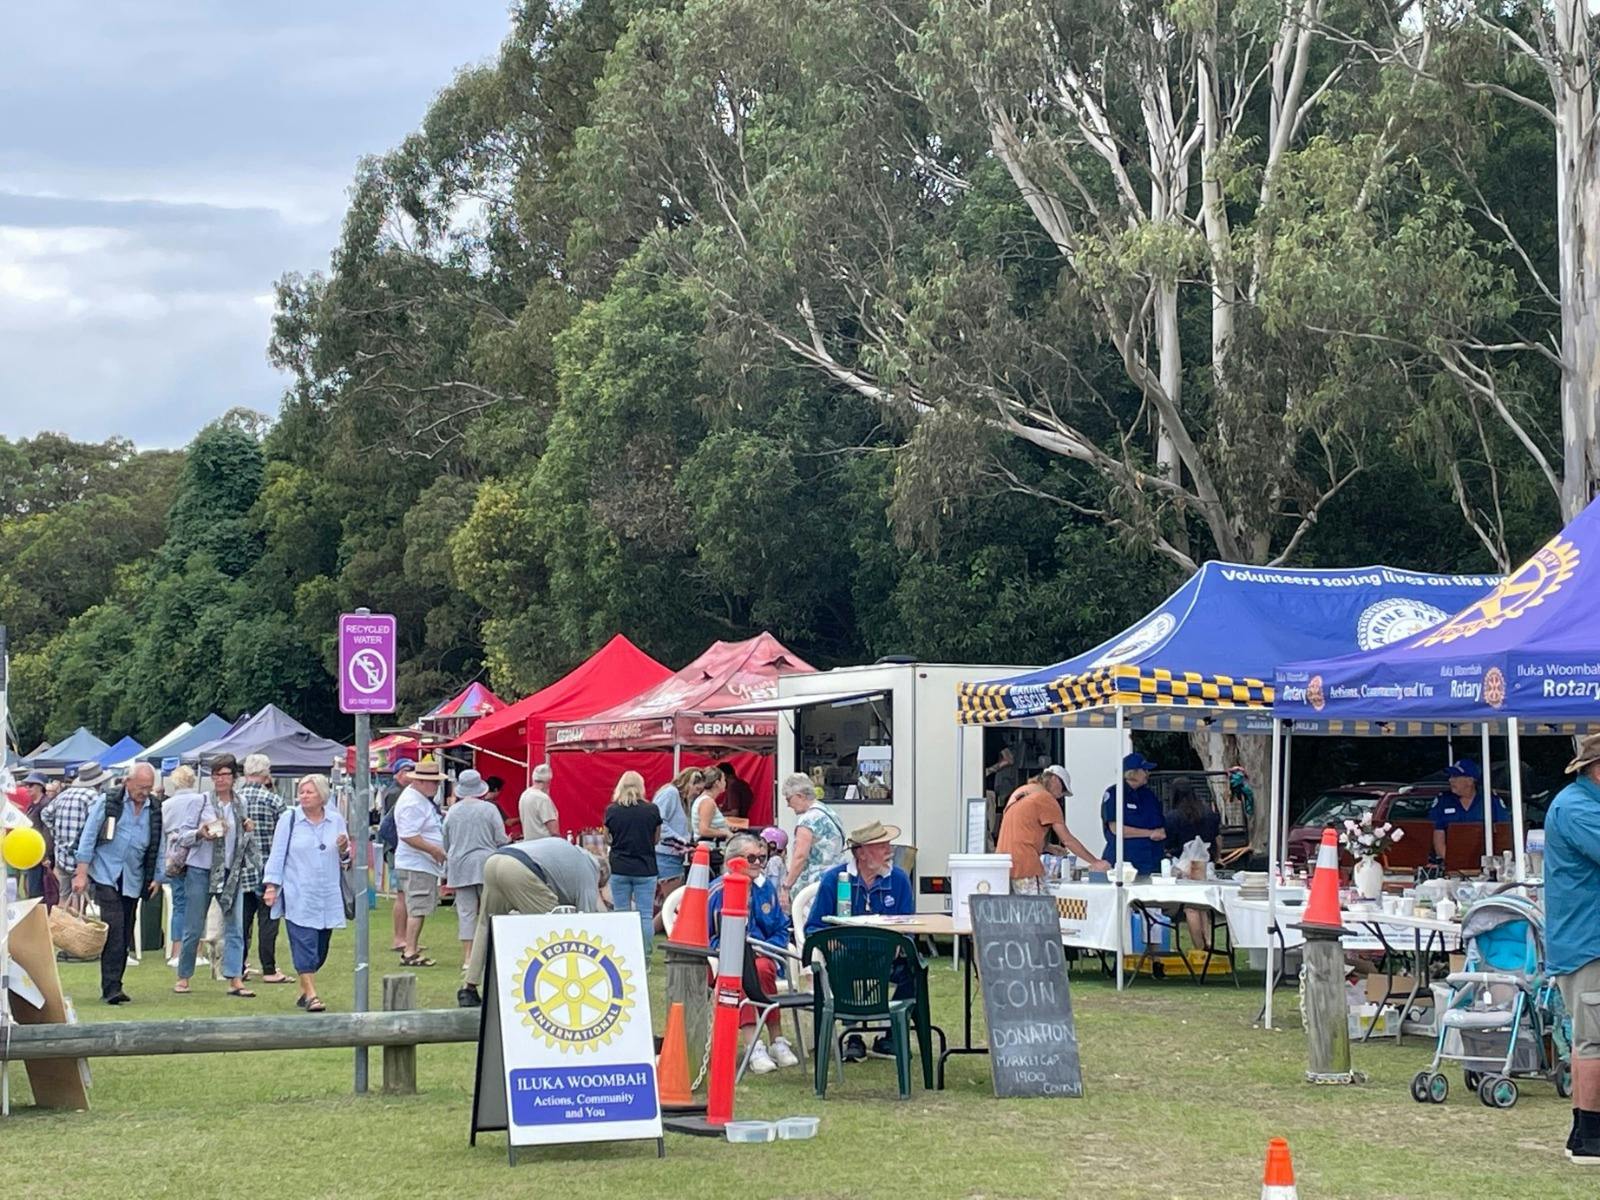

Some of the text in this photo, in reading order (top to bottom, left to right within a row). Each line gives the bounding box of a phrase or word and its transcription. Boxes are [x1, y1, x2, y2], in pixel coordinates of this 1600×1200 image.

[1221, 570, 1320, 586] Volunteers
[1322, 574, 1381, 587] saving
[1381, 570, 1425, 586] lives
[1427, 576, 1452, 586] on
[1453, 575, 1482, 587] the
[346, 625, 390, 634] RECYCLED
[353, 636, 382, 644] WATER
[1517, 664, 1544, 677] Iluka
[1451, 680, 1482, 702] Rotary
[1543, 679, 1600, 700] Rotary
[1012, 693, 1052, 709] RESCUE
[694, 723, 755, 736] GERMAN
[976, 899, 1055, 925] VOLUNTARY
[545, 942, 595, 959] ROTARY
[984, 940, 1060, 970] GOLD
[991, 980, 1055, 1008] COIN
[533, 1008, 619, 1041] INTERNATIONAL
[992, 1022, 1076, 1049] DONATION
[517, 1072, 648, 1091] ILUKA WOOMBAH
[1015, 1070, 1047, 1083] 1900
[534, 1090, 635, 1107] Actions, Community
[565, 1106, 606, 1119] and You
